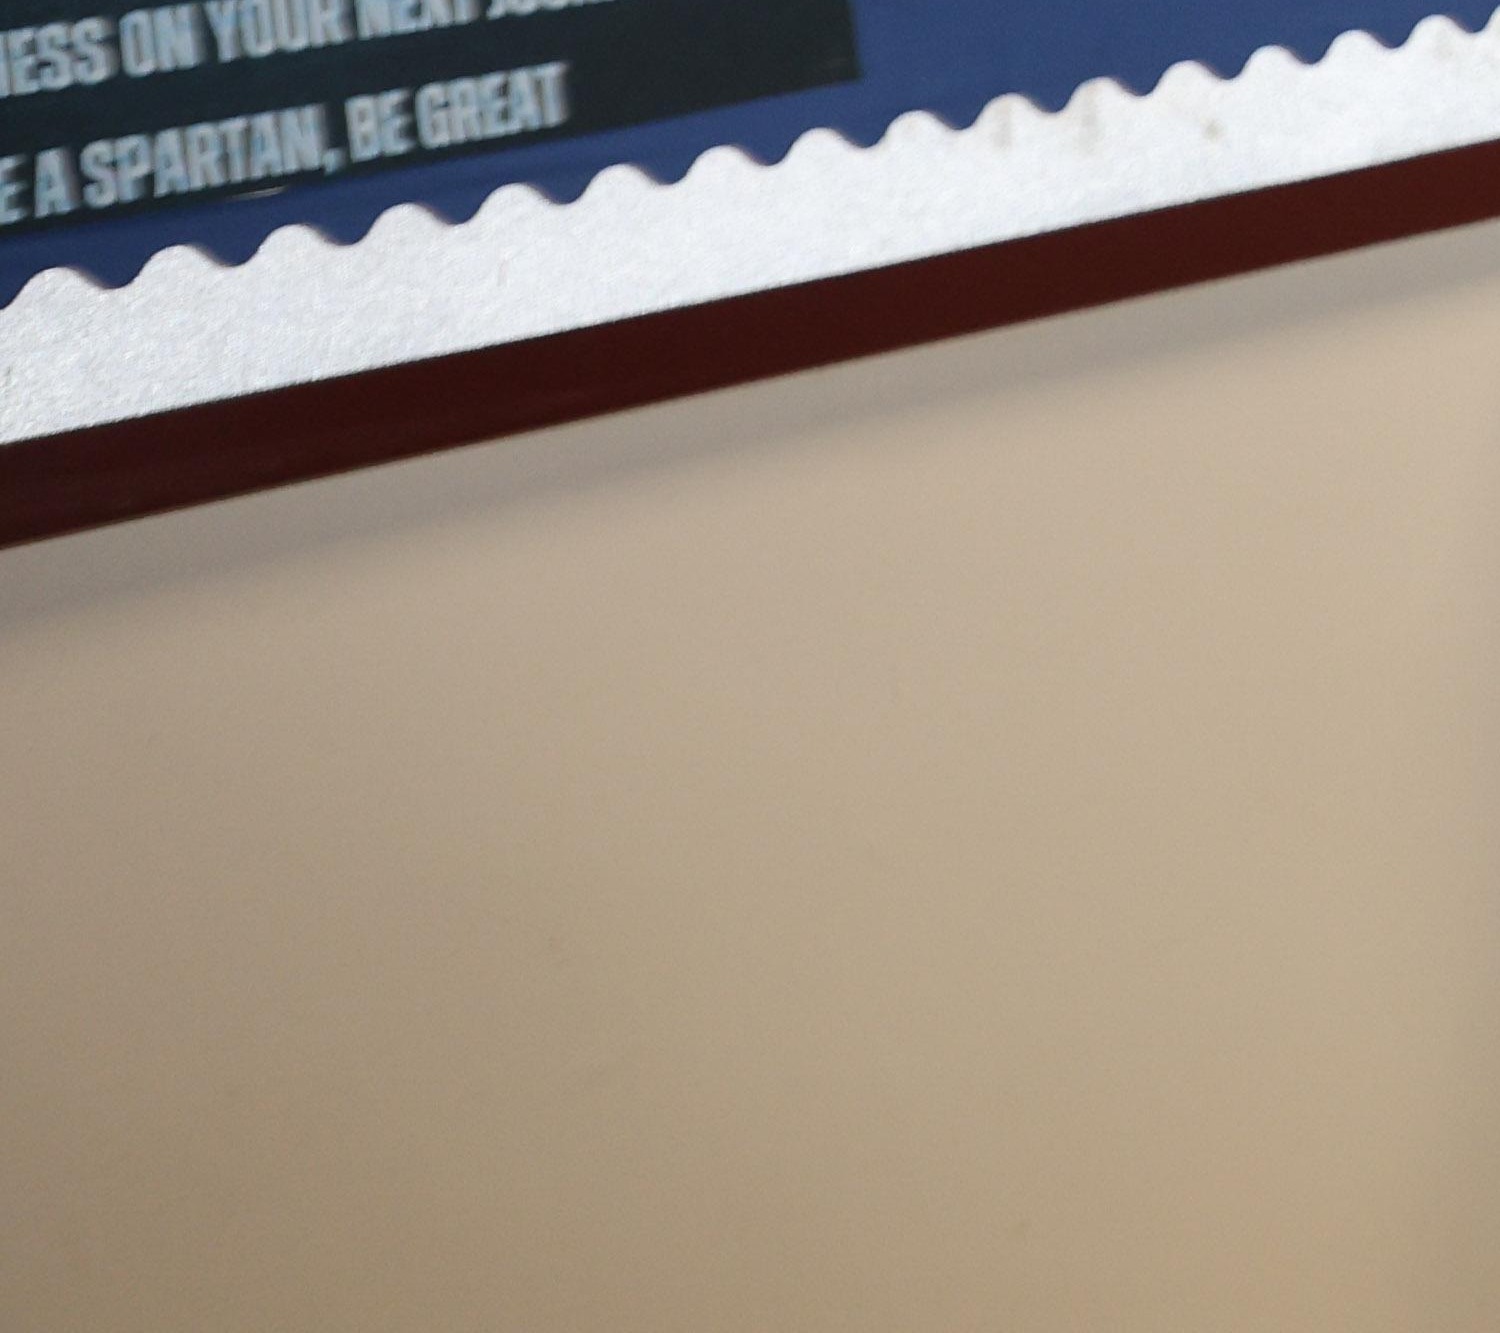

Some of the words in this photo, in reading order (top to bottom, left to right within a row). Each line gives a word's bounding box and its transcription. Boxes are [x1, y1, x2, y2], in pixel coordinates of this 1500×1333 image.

[119, 2, 202, 79] ON
[33, 145, 78, 218] A
[79, 103, 345, 209] SPARTAN,
[345, 87, 414, 164] BE
[414, 61, 569, 151] GREAT
